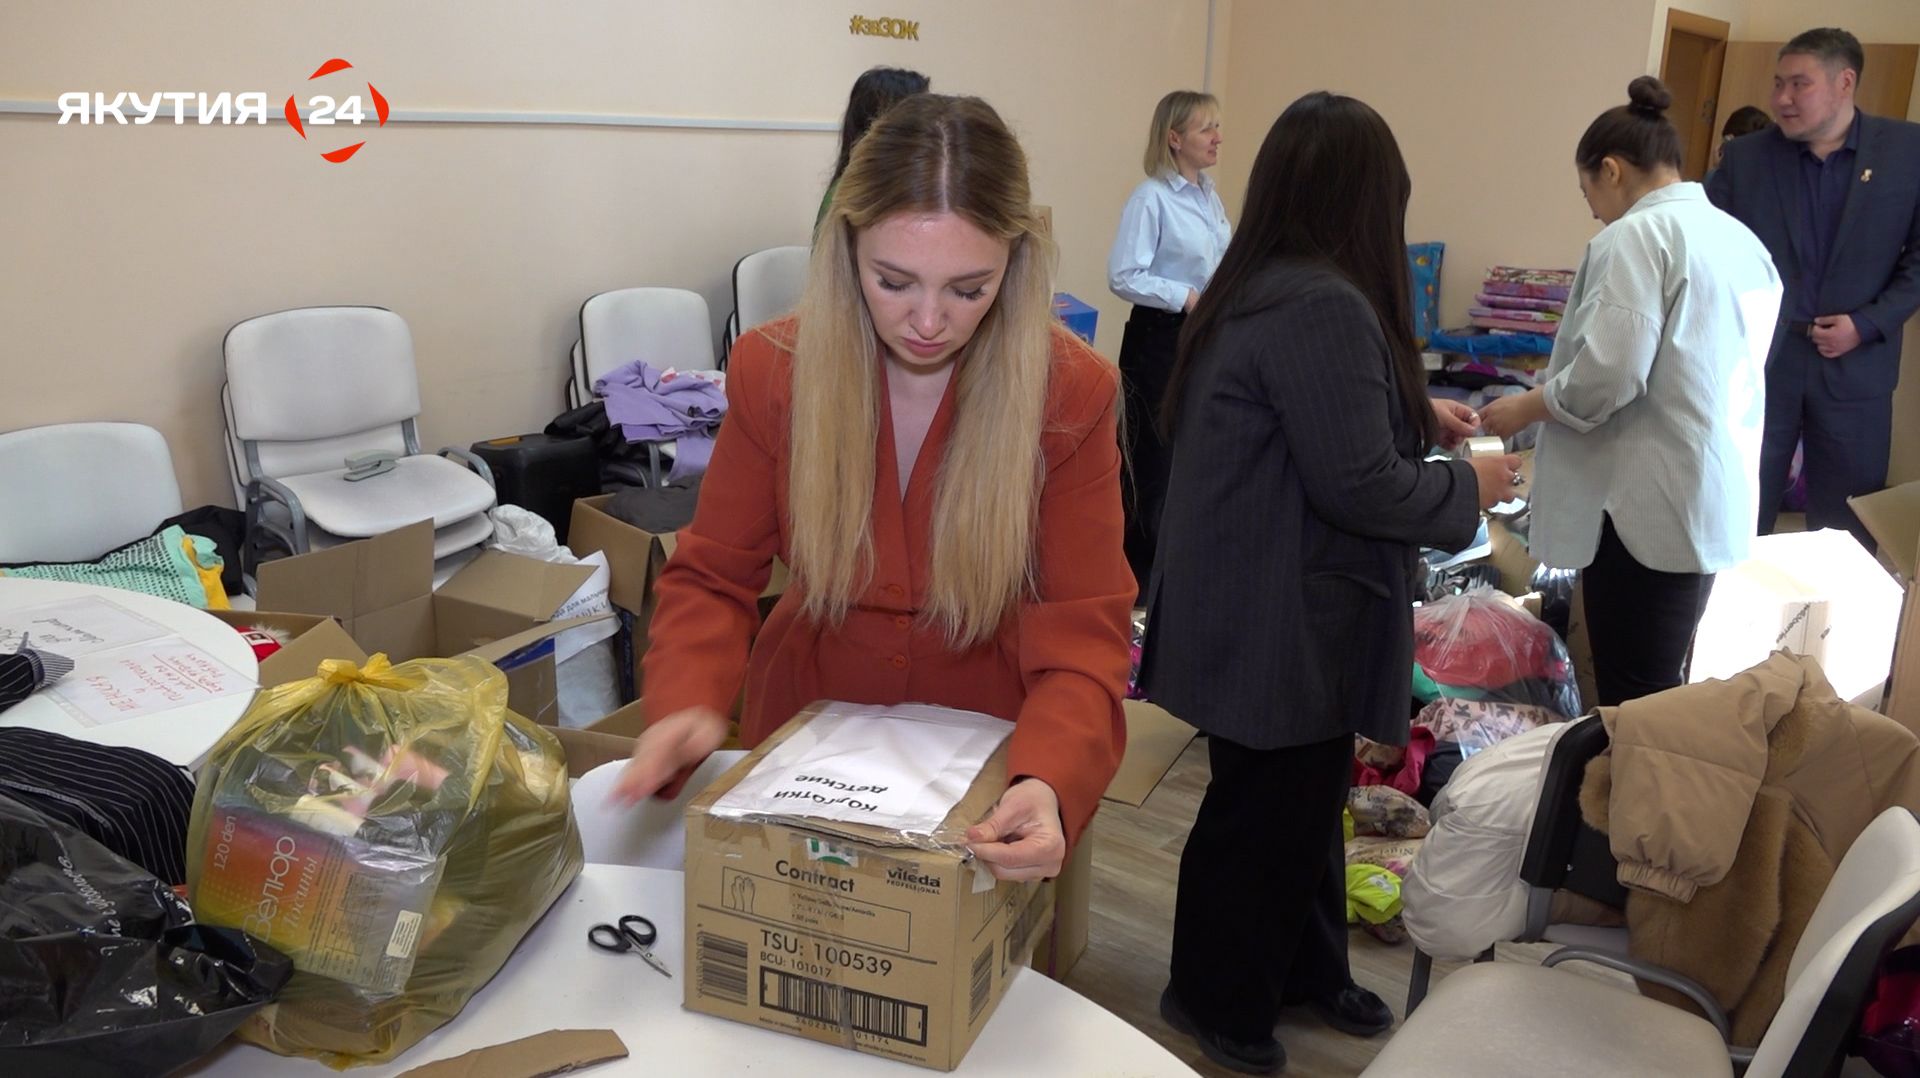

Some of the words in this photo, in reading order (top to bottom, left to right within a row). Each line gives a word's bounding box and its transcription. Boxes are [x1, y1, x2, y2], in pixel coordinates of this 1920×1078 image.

[221, 815, 237, 842] den
[213, 843, 231, 870] 120
[241, 836, 299, 943] Велюр
[775, 859, 855, 893] Contract
[887, 867, 941, 888] vileda
[760, 928, 804, 957] TSU:
[814, 943, 893, 977] 100539
[760, 951, 787, 967] BCU:
[790, 958, 832, 979] 101017
